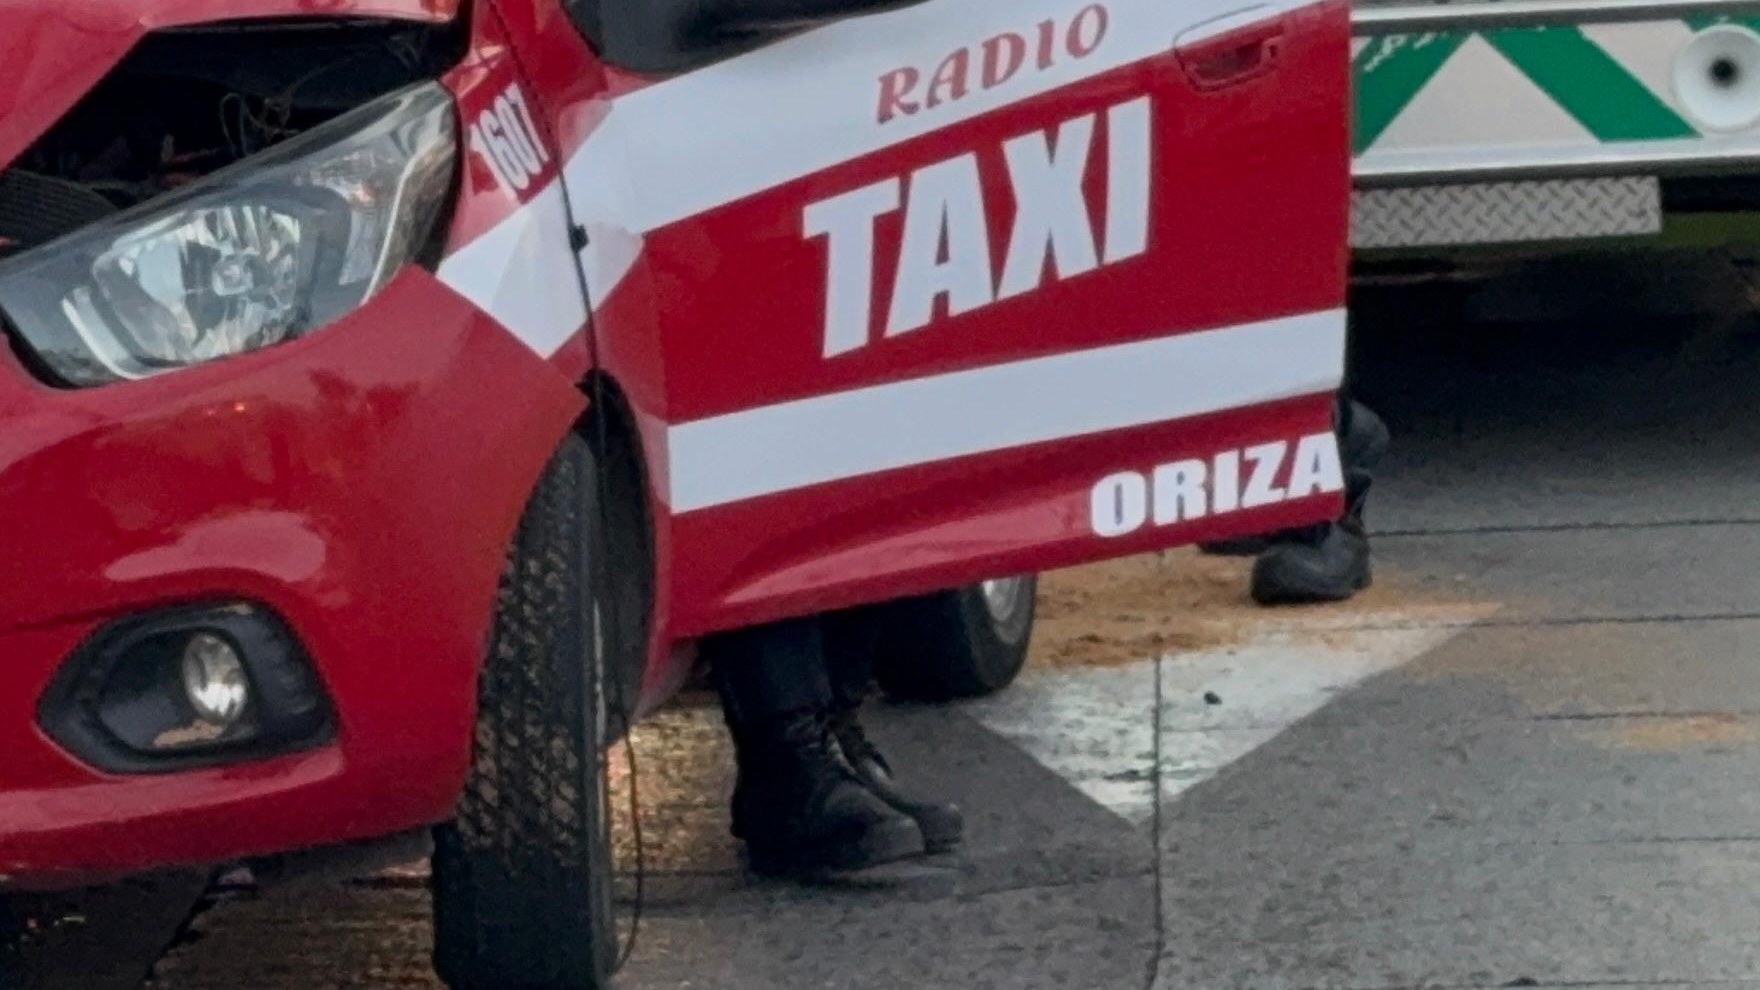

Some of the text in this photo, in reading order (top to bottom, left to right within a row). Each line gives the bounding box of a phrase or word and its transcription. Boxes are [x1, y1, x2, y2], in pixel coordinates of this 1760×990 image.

[876, 2, 1108, 125] RADIO
[469, 82, 550, 202] 1607
[802, 94, 1152, 360] TAXI
[1091, 430, 1345, 538] ORIZA
